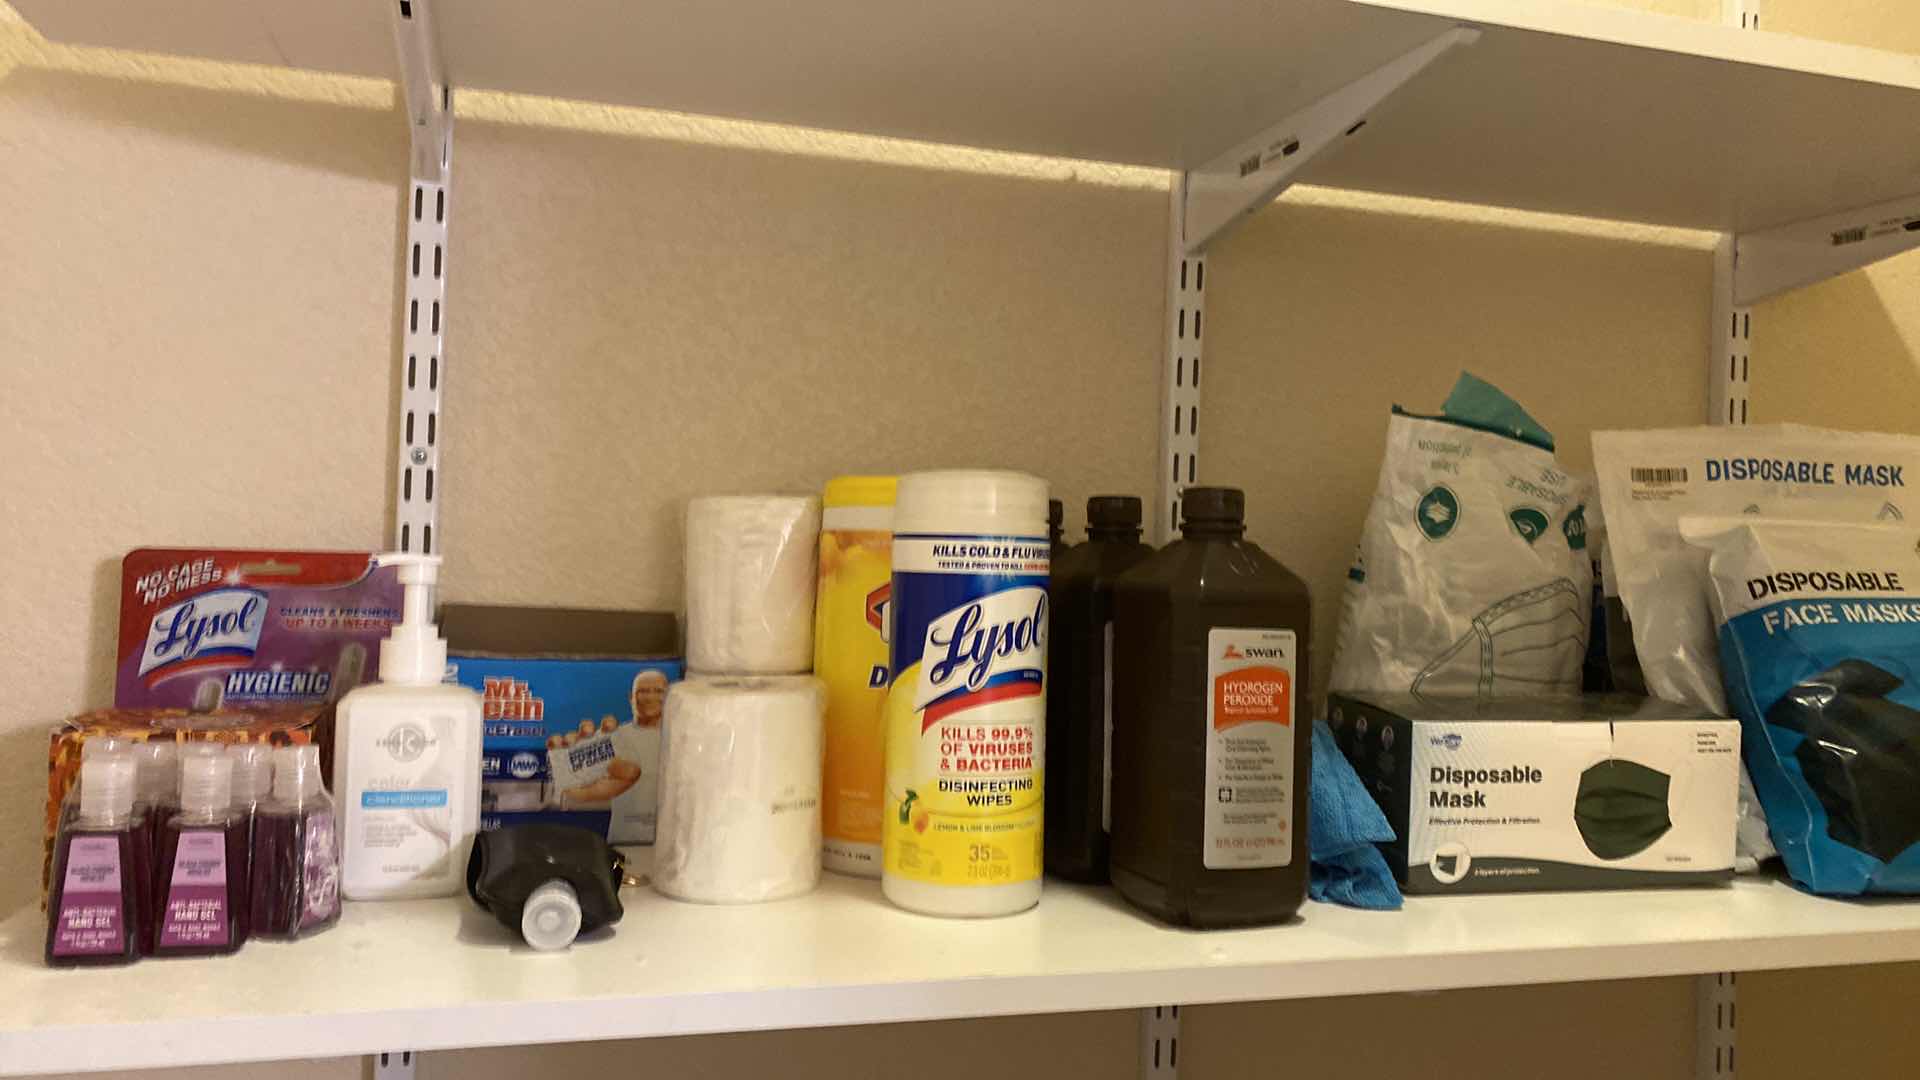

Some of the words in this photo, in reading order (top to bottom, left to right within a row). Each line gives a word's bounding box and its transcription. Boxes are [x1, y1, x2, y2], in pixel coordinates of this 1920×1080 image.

[1706, 458, 1834, 485] DISPOSABLE
[1844, 464, 1905, 487] MASK
[933, 545, 967, 558] KILLS
[969, 546, 1001, 558] COLD
[1002, 547, 1010, 559] &
[1012, 548, 1033, 559] FLU
[136, 571, 163, 594] NO
[168, 557, 215, 582] CAGE
[144, 583, 171, 605] NO
[176, 568, 222, 592] MESS
[1747, 572, 1905, 601] DISPOSABLE
[153, 598, 259, 657] Lysol
[1761, 603, 1840, 635] FACE
[930, 592, 1046, 691] Lysol
[227, 672, 330, 694] HYGIENIC
[1223, 681, 1283, 695] HYDROGEN
[1223, 694, 1274, 706] PEROXIDE
[941, 727, 985, 741] KILLS
[991, 726, 1033, 741] 99.9%
[940, 741, 962, 756] OF
[969, 741, 1033, 756] VIRUSES
[939, 757, 950, 770] &
[956, 756, 1033, 772] BACTERIA
[938, 778, 1033, 793] DISINFECTING
[1430, 767, 1543, 788] Disposable
[966, 795, 1013, 807] WIPES
[1429, 791, 1486, 809] Mask
[1429, 816, 1462, 826] Effective
[1463, 816, 1501, 825] Protection
[1508, 816, 1541, 825] Filtration
[969, 844, 990, 862] 35
